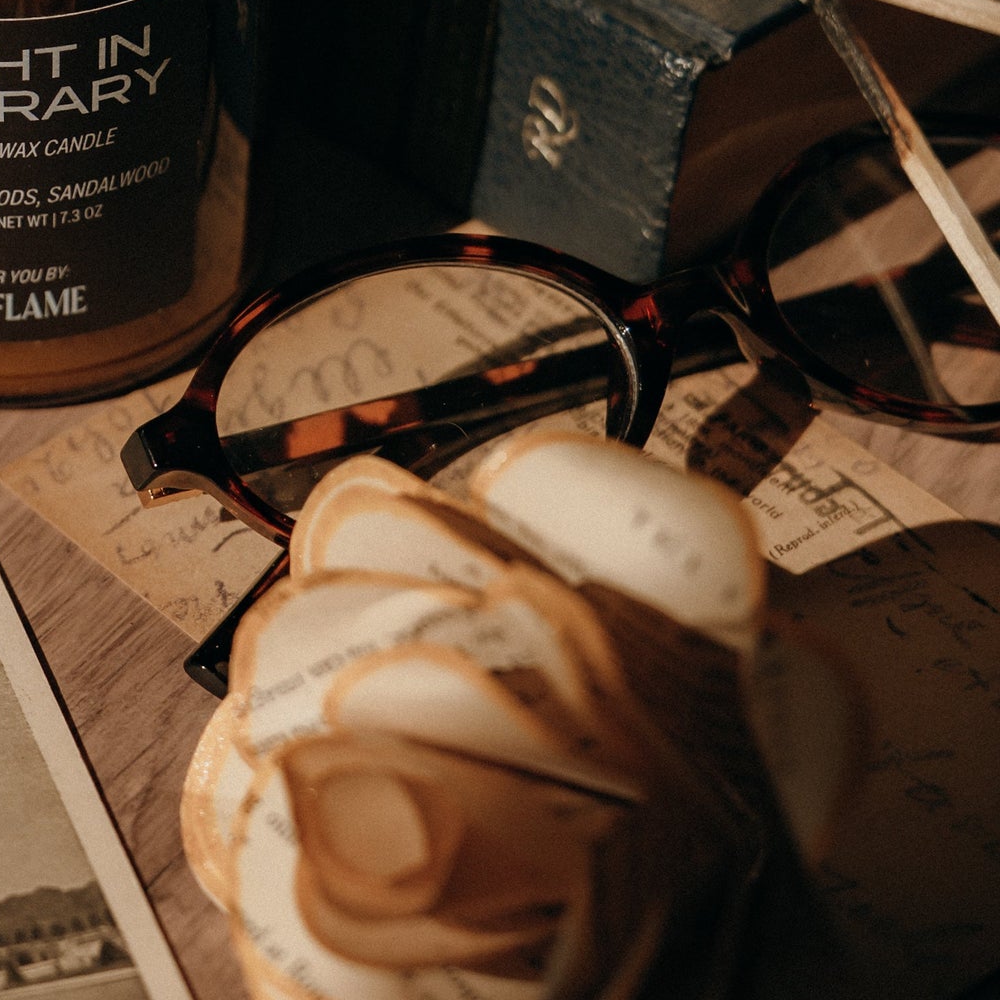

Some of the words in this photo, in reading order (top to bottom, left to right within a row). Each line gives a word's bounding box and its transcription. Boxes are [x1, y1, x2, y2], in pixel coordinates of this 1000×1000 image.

[98, 24, 151, 70] IN
[0, 141, 41, 158] WAX
[44, 126, 118, 156] CANDLE
[47, 156, 170, 203] SANDALWOOD
[27, 213, 48, 227] WT
[60, 208, 80, 224] 7.3
[84, 203, 104, 220] OZ
[10, 267, 43, 284] YOU
